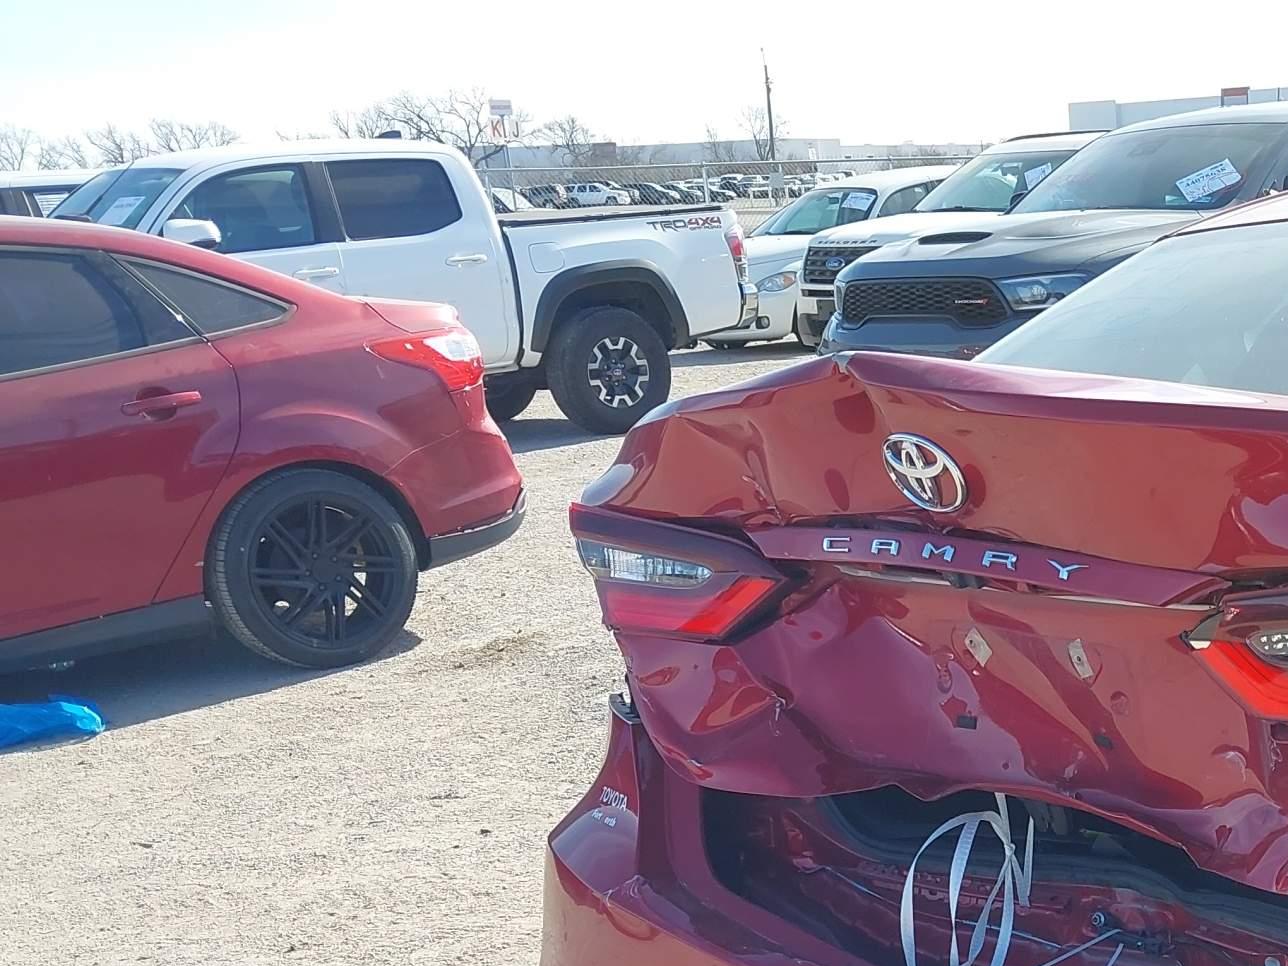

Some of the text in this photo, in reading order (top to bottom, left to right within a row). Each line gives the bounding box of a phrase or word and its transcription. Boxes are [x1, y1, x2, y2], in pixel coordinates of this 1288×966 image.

[646, 219, 688, 232] TRD
[822, 536, 1089, 581] CAMRY
[600, 785, 628, 812] TOYOTA
